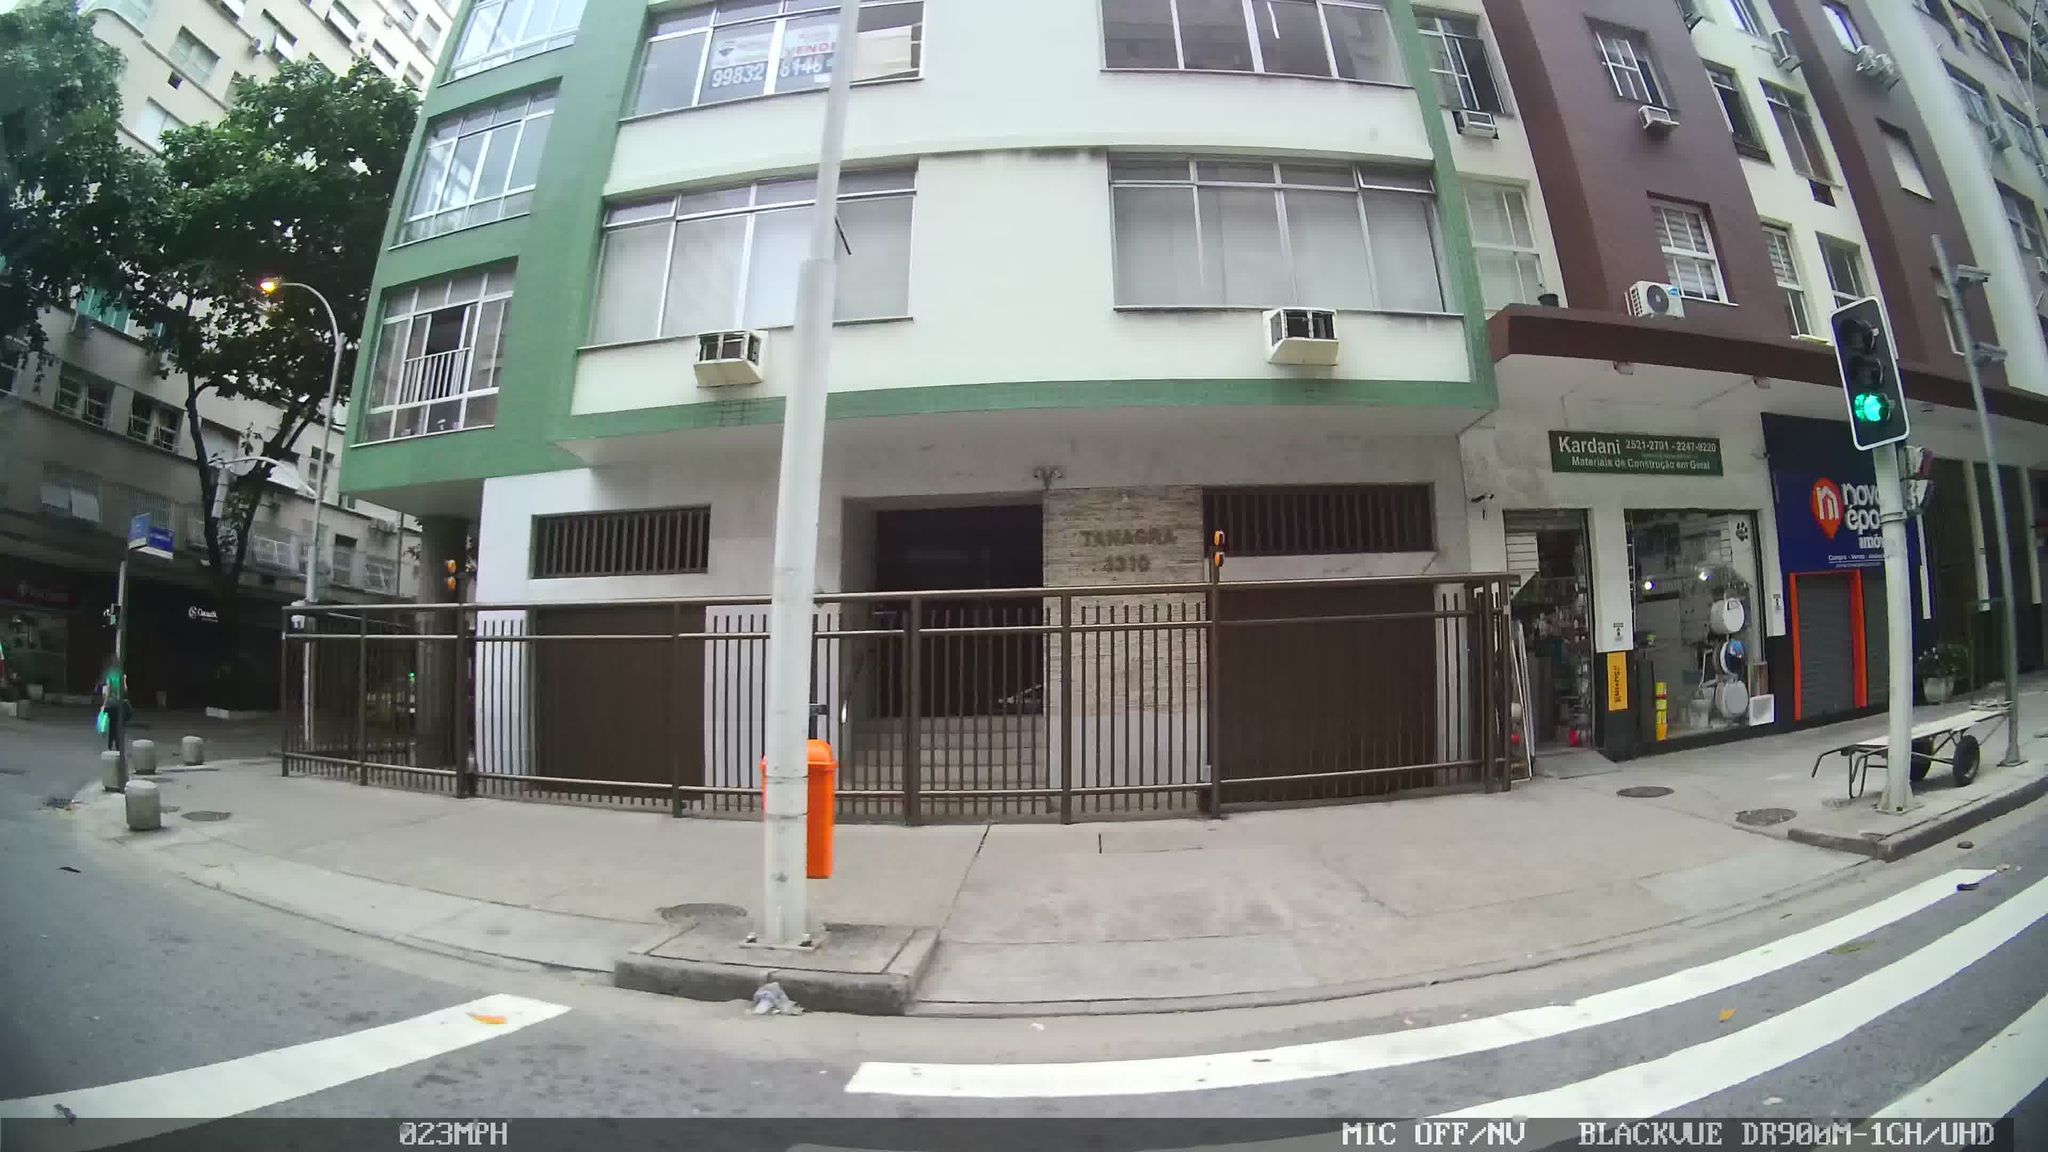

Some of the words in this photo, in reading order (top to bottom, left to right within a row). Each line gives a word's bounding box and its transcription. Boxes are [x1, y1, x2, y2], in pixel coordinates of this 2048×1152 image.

[1558, 435, 1621, 456] Kardani
[1614, 458, 1627, 468] de
[1627, 458, 1675, 470] Construção
